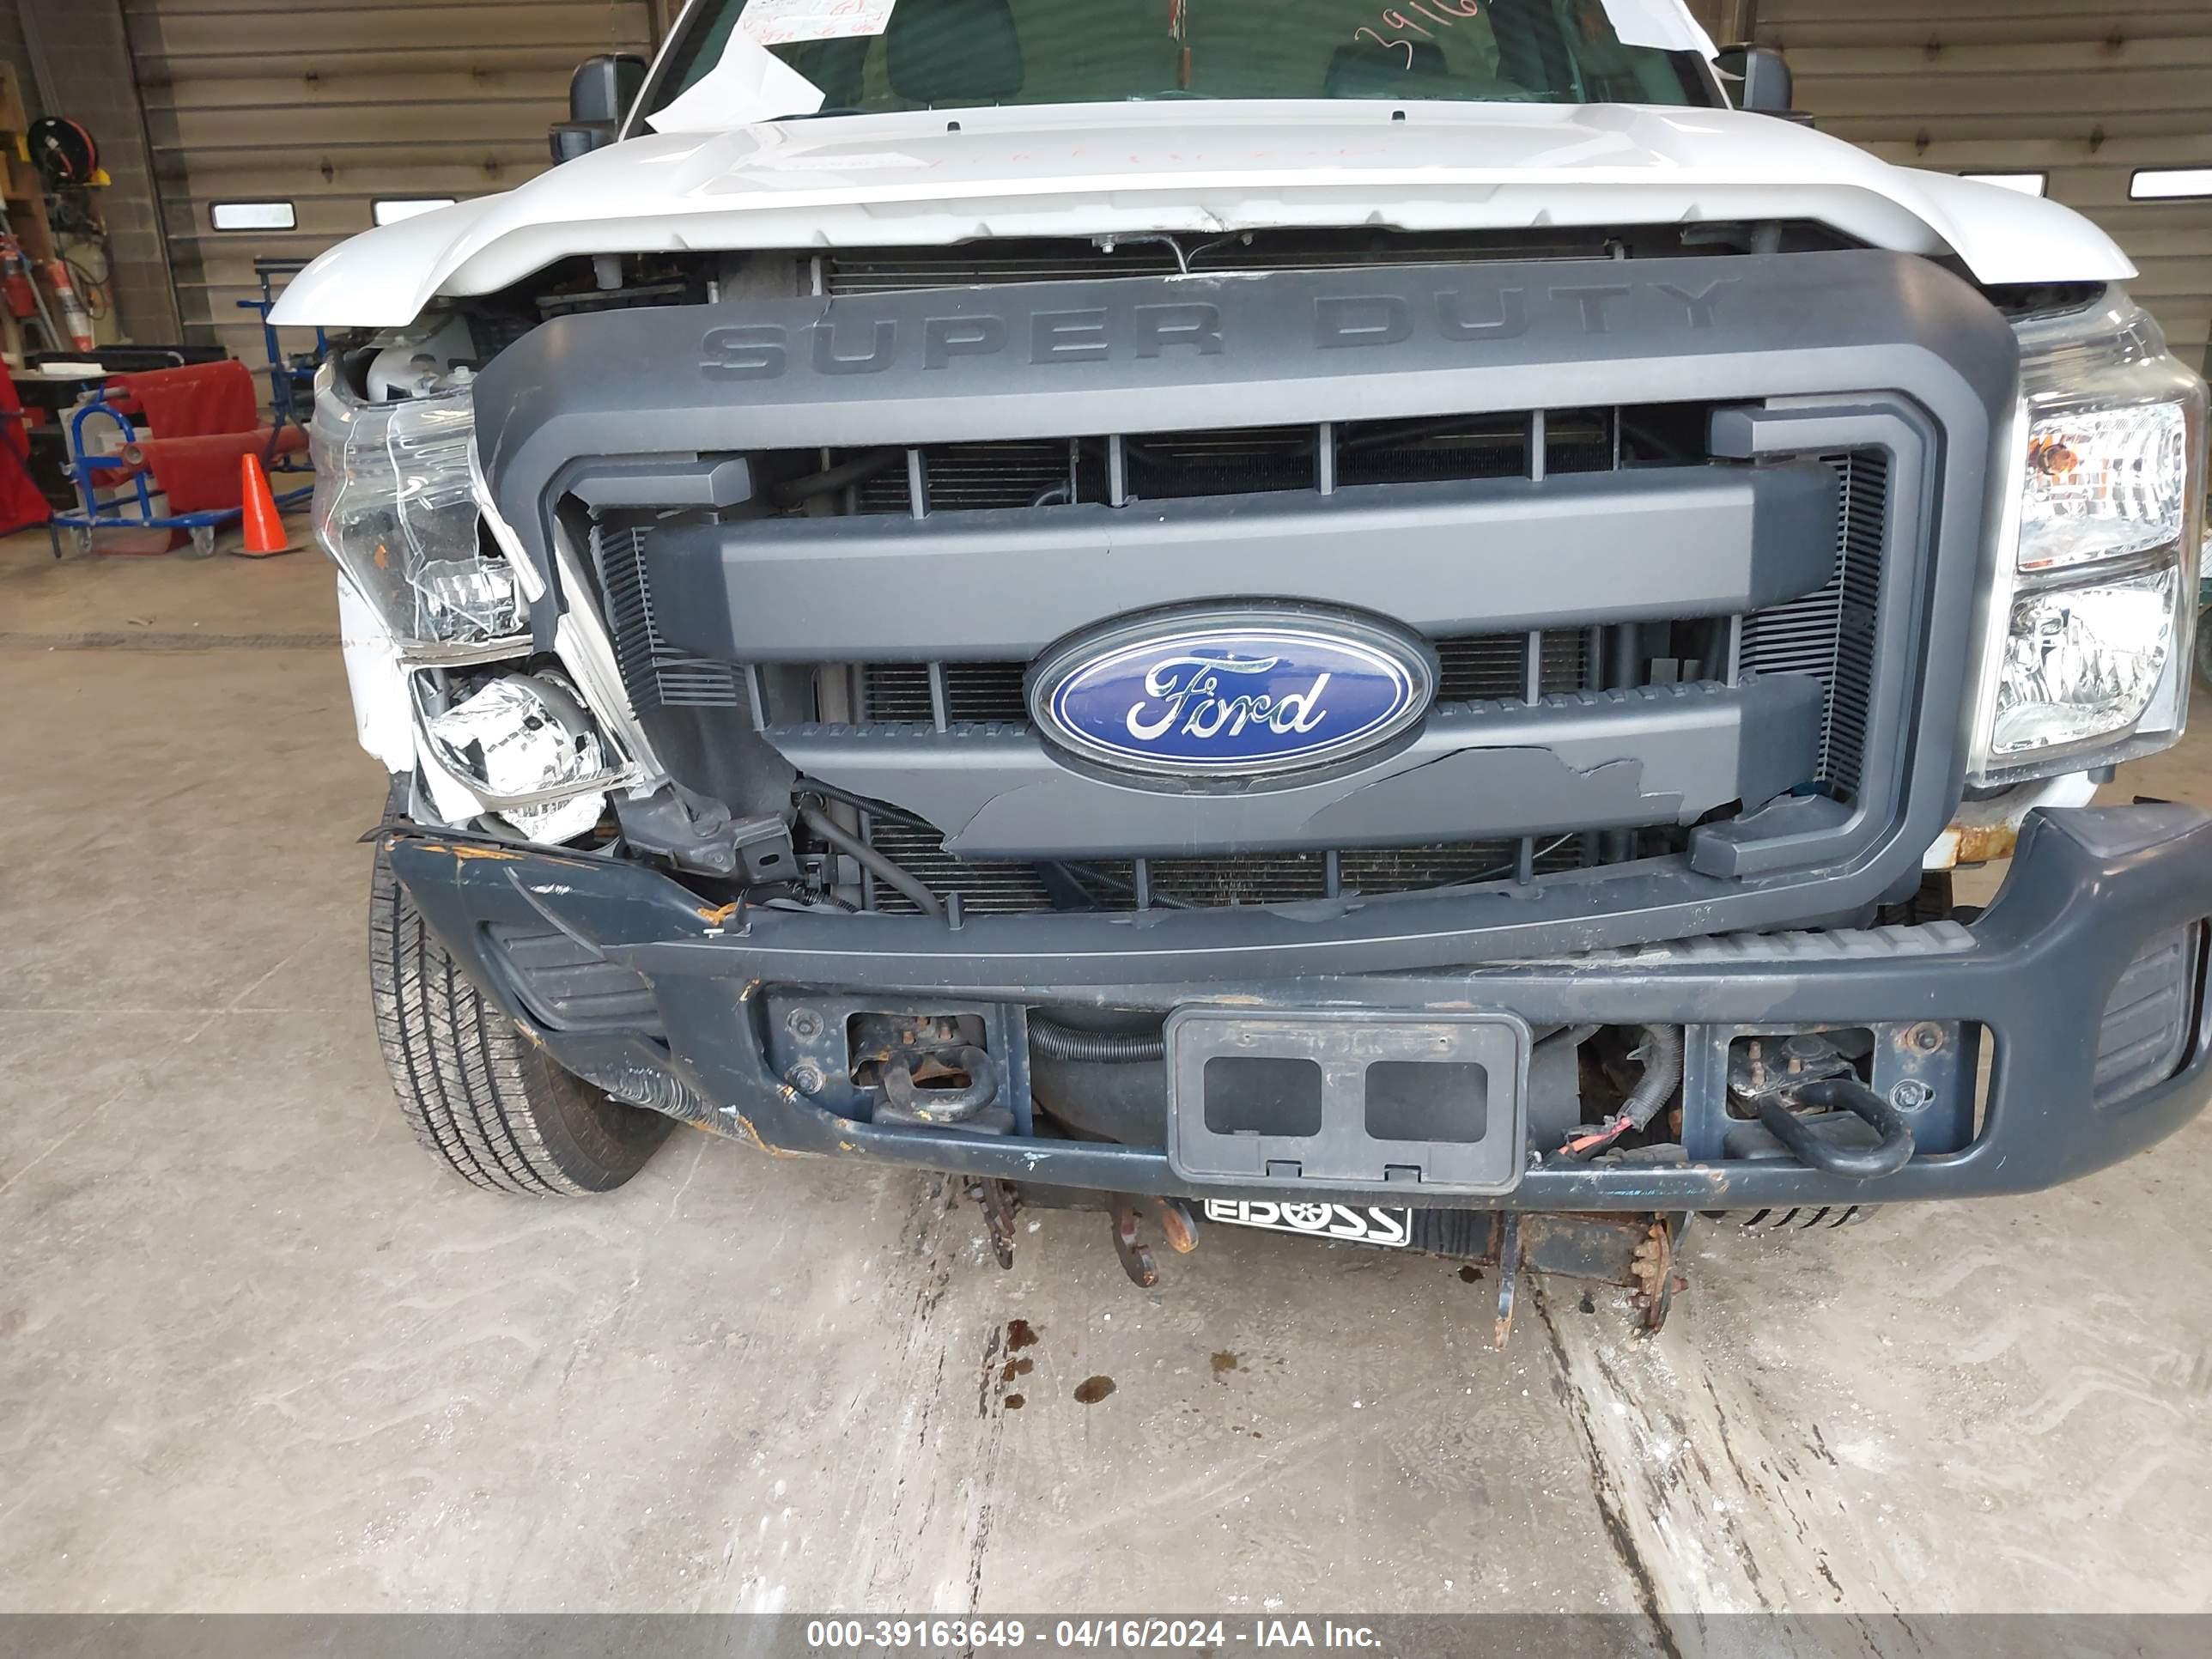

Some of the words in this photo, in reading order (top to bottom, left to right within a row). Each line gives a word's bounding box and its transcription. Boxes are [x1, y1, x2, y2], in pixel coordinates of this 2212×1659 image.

[699, 301, 1224, 381] SUPER
[1313, 276, 1745, 349] DUTY
[1126, 655, 1333, 741] Ford
